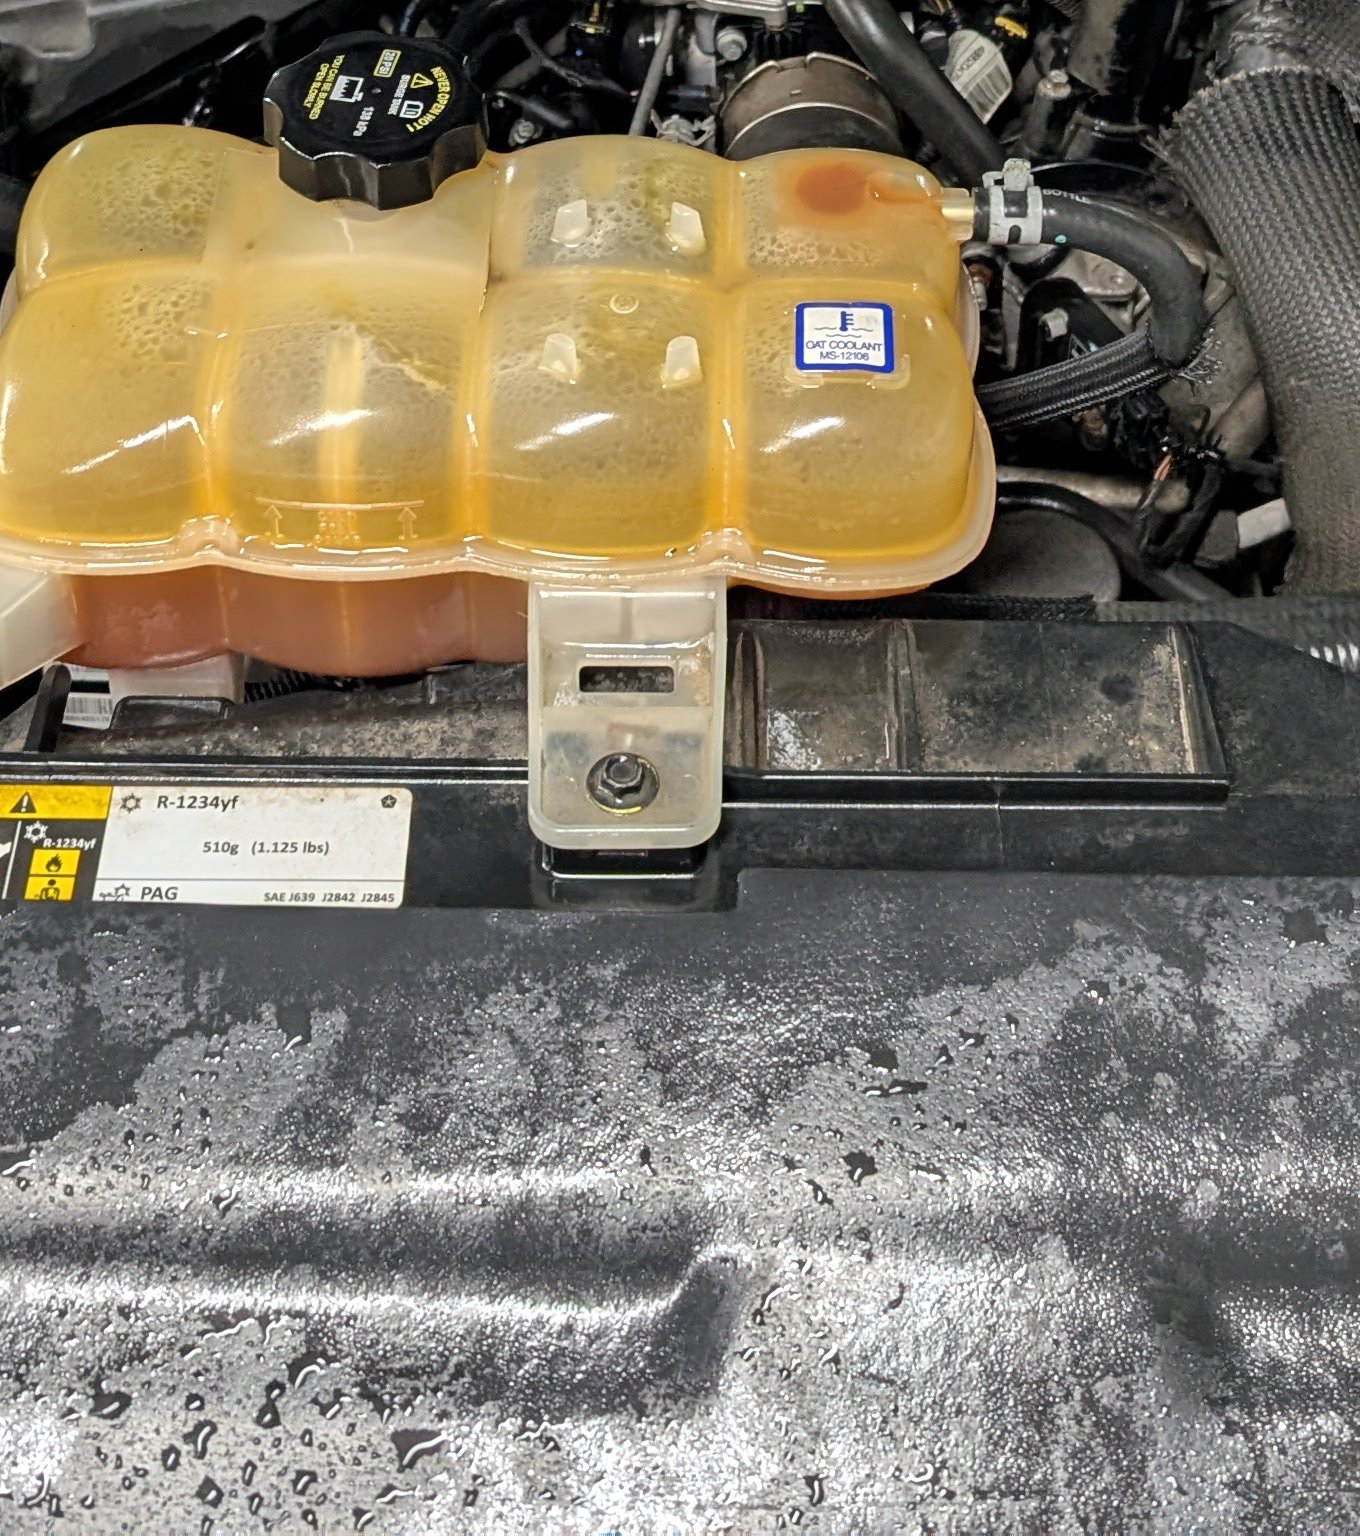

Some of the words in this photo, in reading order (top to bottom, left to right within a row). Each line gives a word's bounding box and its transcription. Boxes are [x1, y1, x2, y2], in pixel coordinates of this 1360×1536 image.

[331, 54, 345, 69] YOU
[378, 61, 393, 75] PSI
[314, 63, 330, 82] OPEN
[325, 68, 338, 83] CAN
[430, 66, 451, 93] NEVER
[303, 81, 321, 108] SLOWLY
[321, 82, 332, 92] BE
[308, 92, 328, 120] BURNED
[428, 93, 451, 116] OPEN
[829, 340, 883, 352] COOLANT
[157, 794, 240, 812] R-1234yf
[43, 837, 97, 851] R-1234yf
[202, 841, 240, 856] 510g
[251, 841, 300, 856] (1.125
[301, 841, 330, 856] lbs)
[140, 886, 179, 901] PAG
[263, 892, 286, 903] SAE
[287, 892, 316, 903] J639
[321, 892, 356, 903] J2842
[360, 892, 396, 904] J2845
